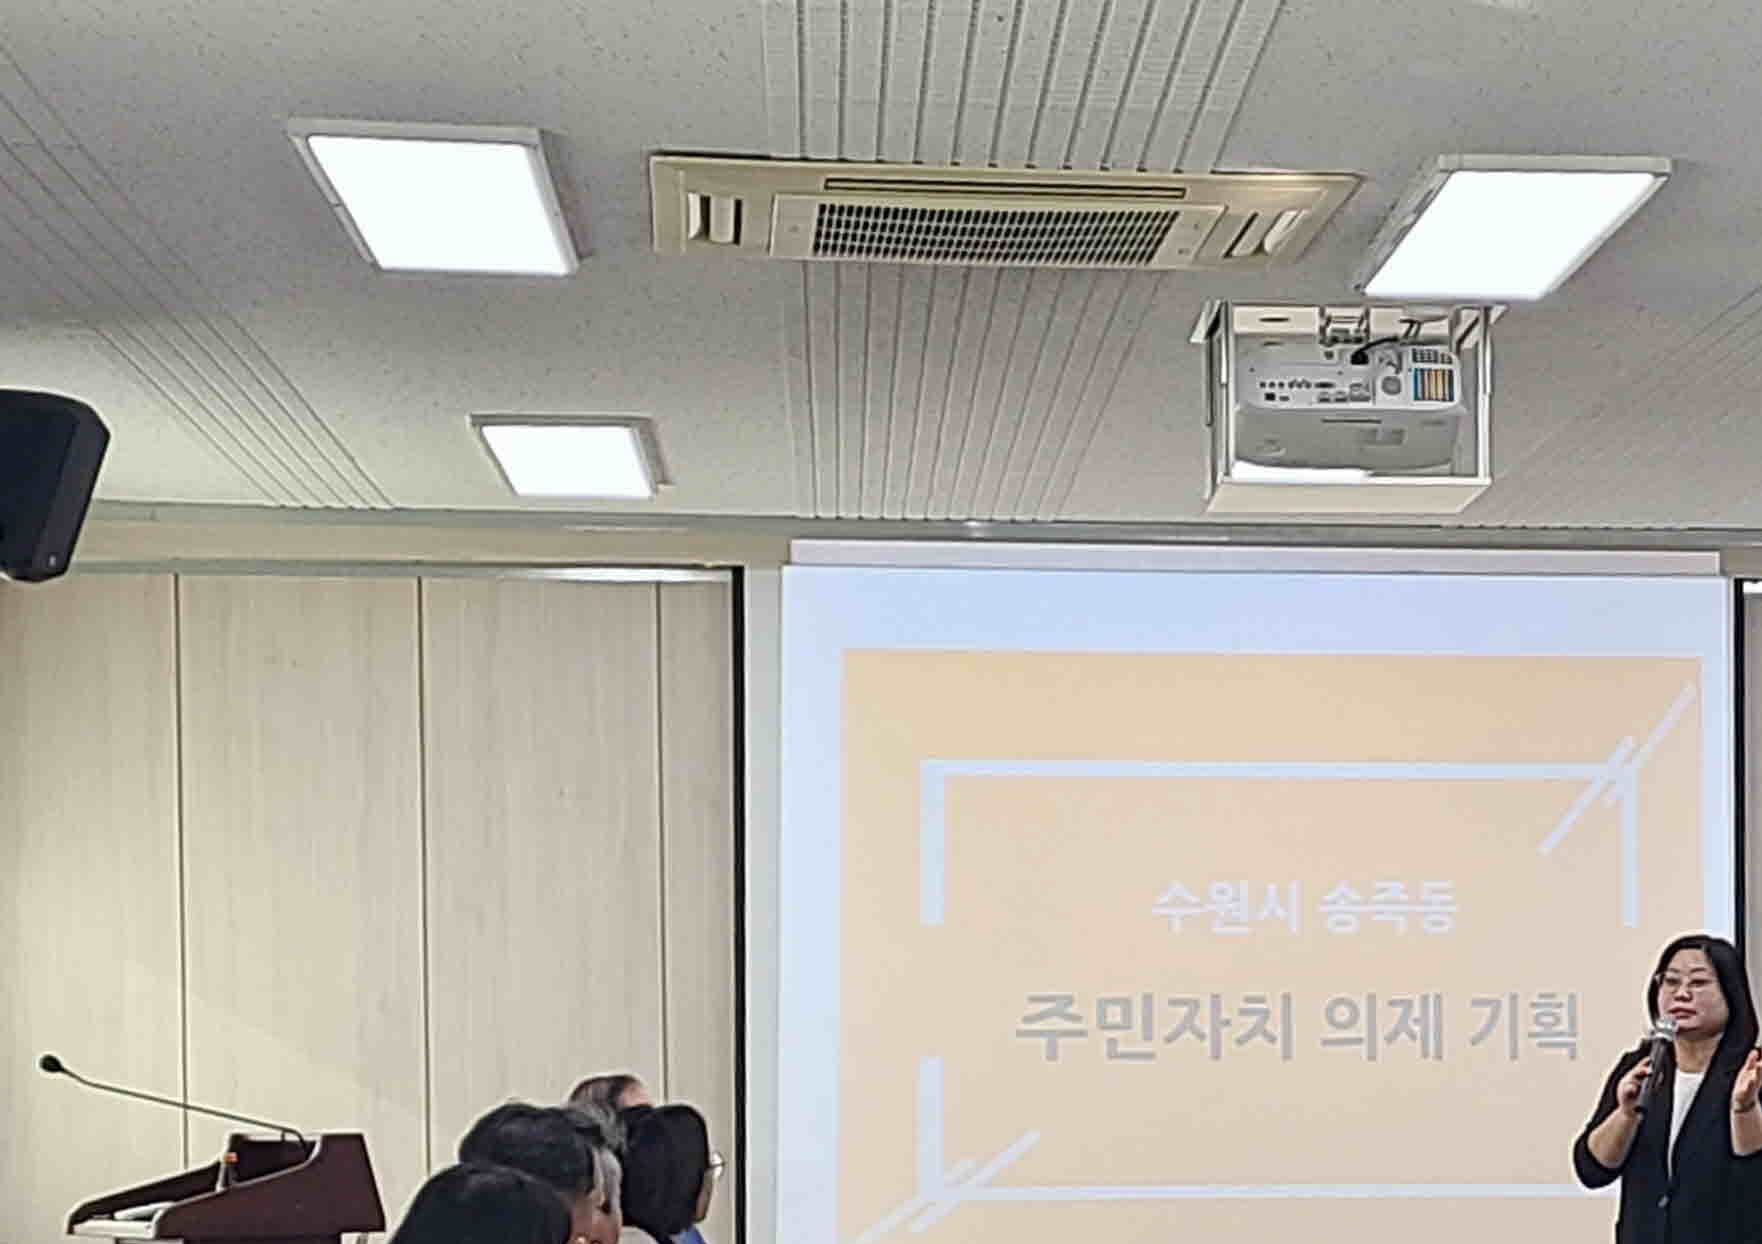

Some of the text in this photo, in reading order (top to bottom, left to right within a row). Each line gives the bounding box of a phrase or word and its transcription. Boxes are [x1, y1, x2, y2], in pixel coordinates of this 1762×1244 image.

[1151, 879, 1299, 936] 수원시
[1015, 991, 1581, 1061] 주민자치 의제 기획
